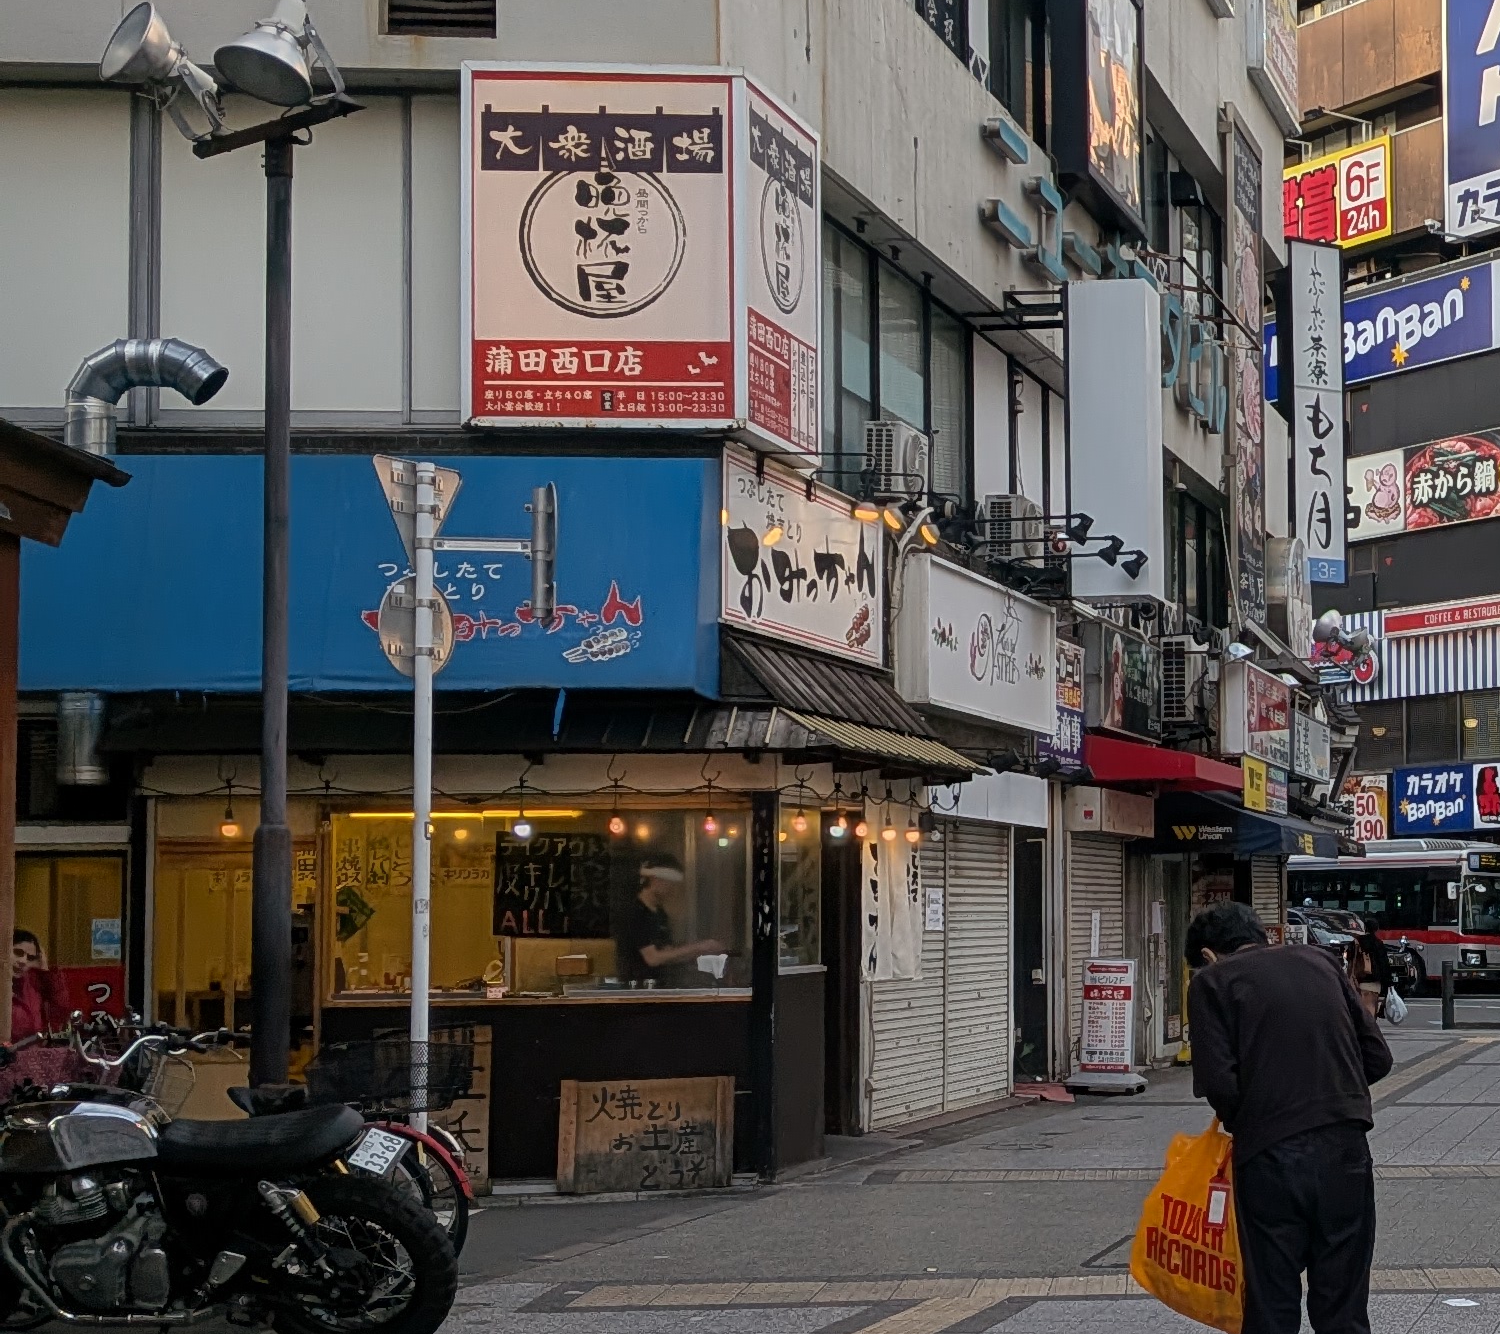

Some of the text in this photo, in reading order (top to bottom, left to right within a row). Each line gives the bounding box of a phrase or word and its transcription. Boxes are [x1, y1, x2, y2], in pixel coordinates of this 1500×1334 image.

[489, 124, 715, 164] 大衆酒場
[752, 125, 813, 199] 大衆酒場
[1346, 160, 1381, 203] 6F
[1347, 210, 1380, 238] 24h
[1301, 252, 1330, 386] しゃぶしゃぶ茶寮
[749, 316, 789, 360] 蒲田西口店
[484, 346, 644, 376] 蒲田西口店
[1305, 393, 1334, 550] もち月
[1413, 459, 1496, 505] 赤から鍋
[1424, 610, 1452, 626] COFFEE
[1406, 771, 1464, 797] カラオケ
[1408, 797, 1466, 823] BanBan
[1198, 825, 1233, 835] Western
[1198, 833, 1223, 841] Union
[501, 909, 551, 935] ALL
[584, 1084, 682, 1124] 焼とり
[612, 1120, 705, 1155] お土産
[640, 1156, 717, 1189] どうぞ
[1146, 1226, 1236, 1296] RECORDS
